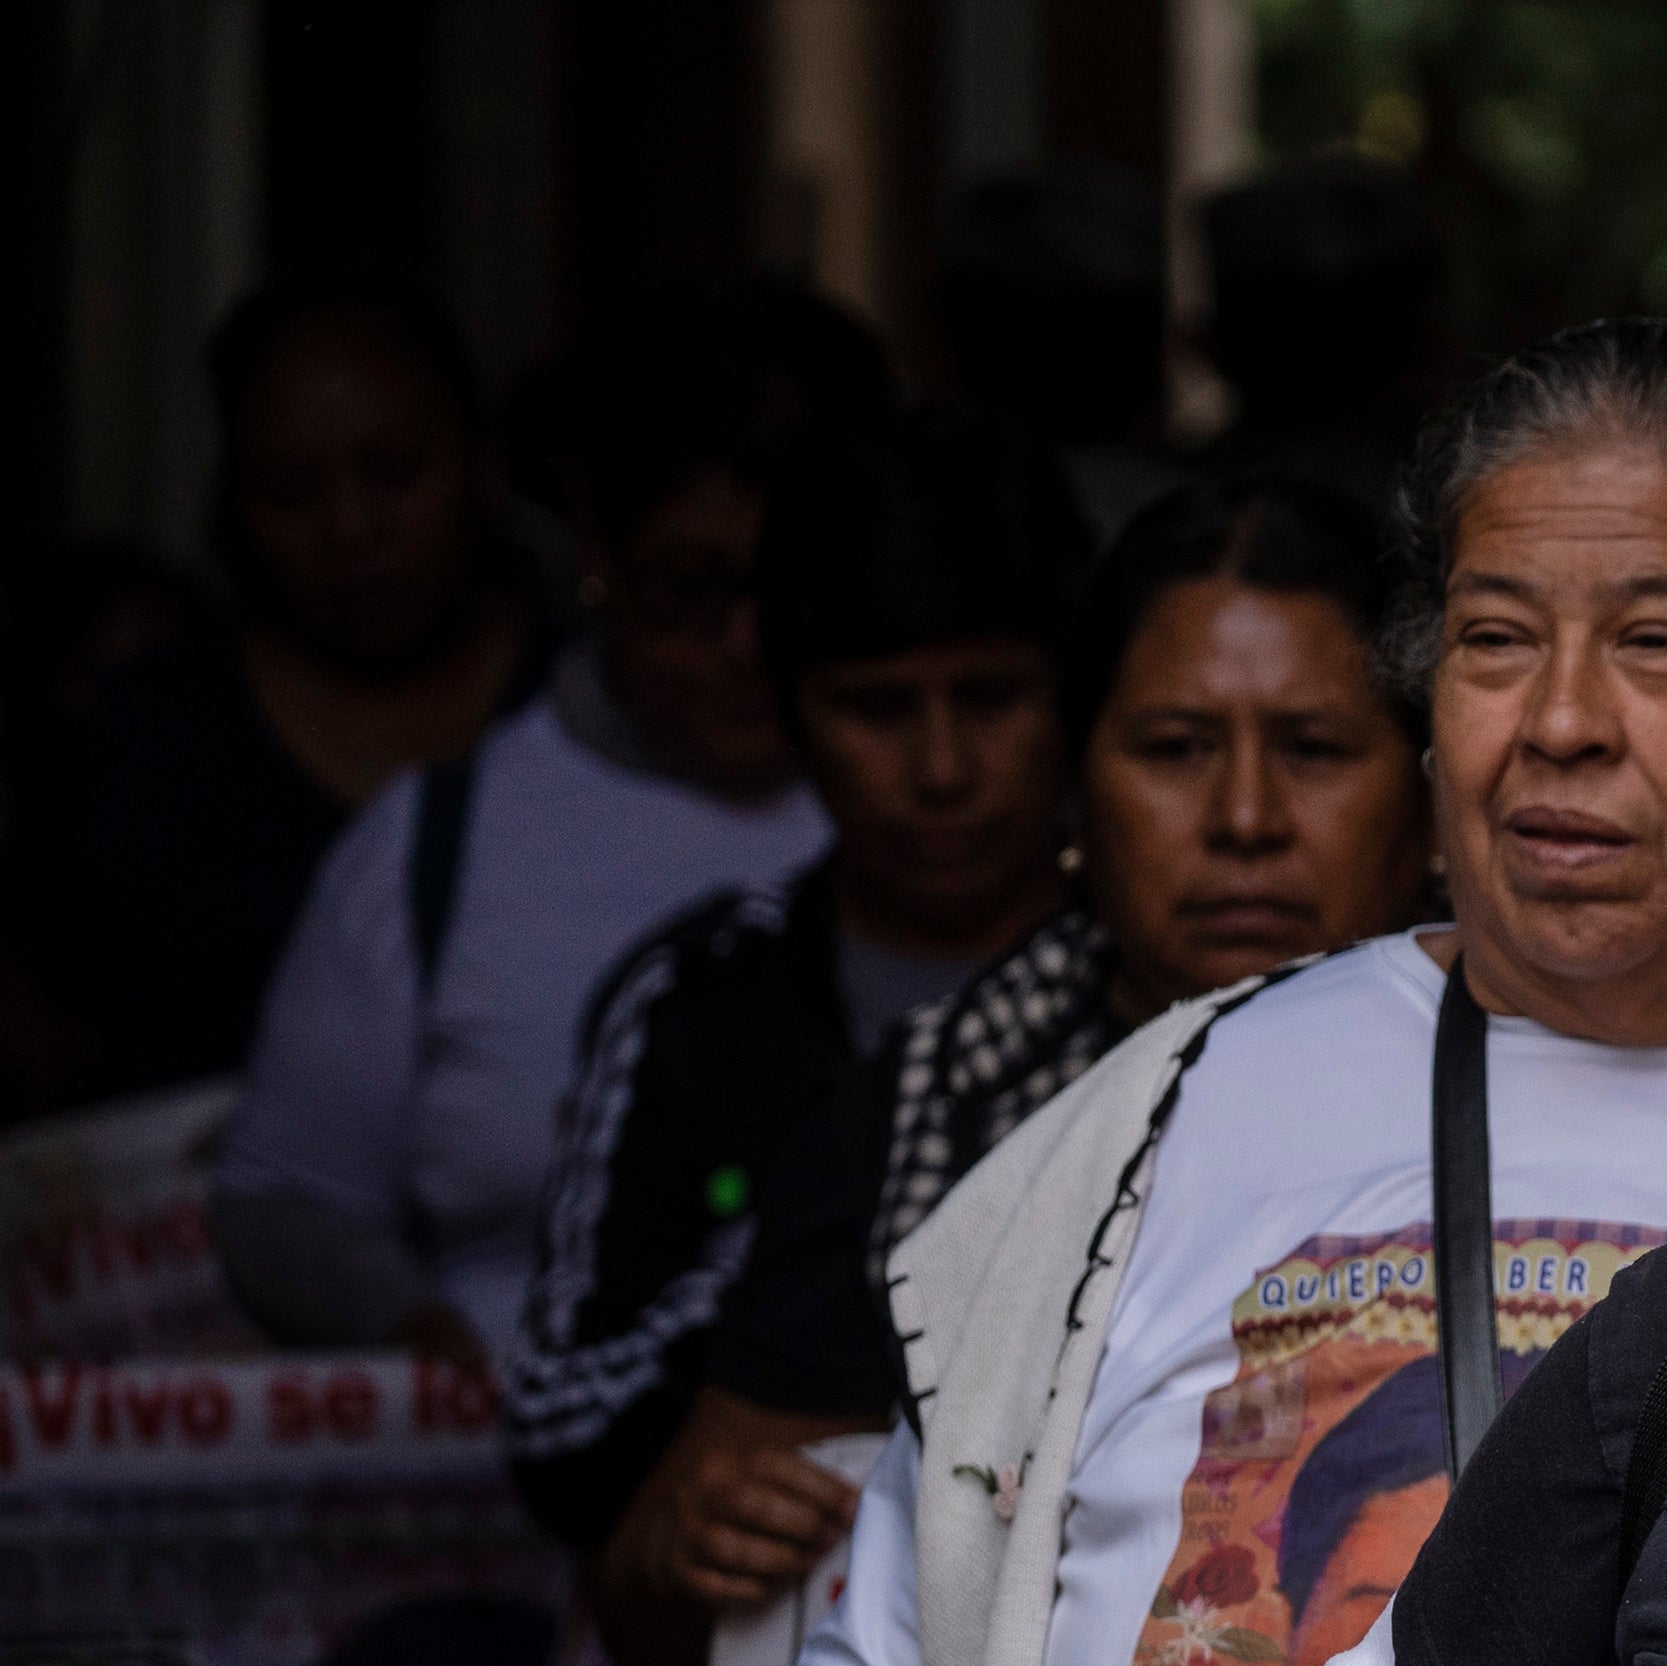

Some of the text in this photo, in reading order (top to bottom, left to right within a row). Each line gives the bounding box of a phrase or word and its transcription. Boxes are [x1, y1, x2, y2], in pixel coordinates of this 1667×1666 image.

[1261, 1255, 1588, 1308] QUIERO BER
[268, 1370, 379, 1444] se
